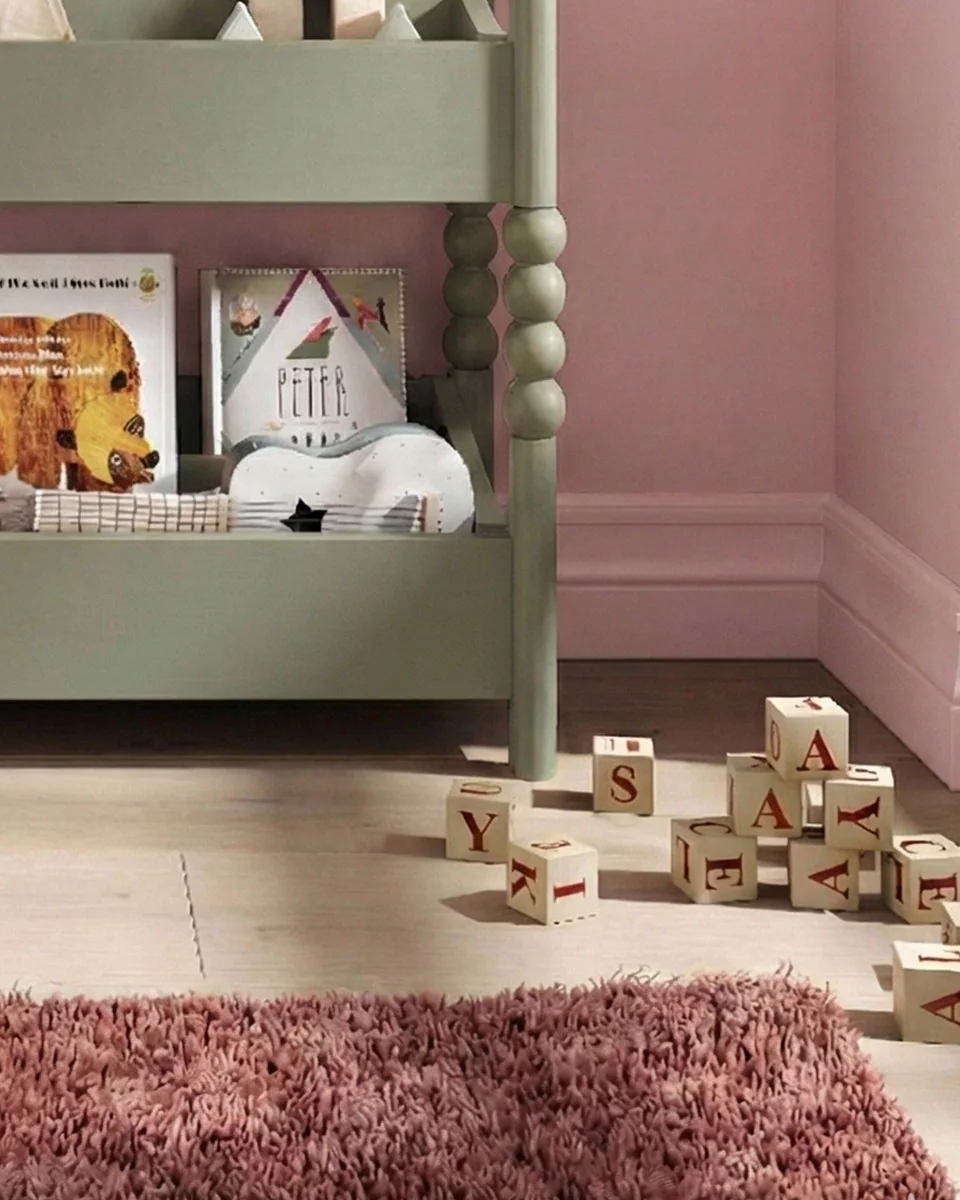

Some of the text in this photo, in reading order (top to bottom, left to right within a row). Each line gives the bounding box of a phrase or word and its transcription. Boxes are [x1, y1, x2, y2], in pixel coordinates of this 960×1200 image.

[796, 728, 840, 772] A
[611, 764, 638, 803] S
[751, 787, 794, 830] A
[458, 810, 499, 853] Y
[705, 852, 743, 891] E
[808, 859, 850, 900] A
